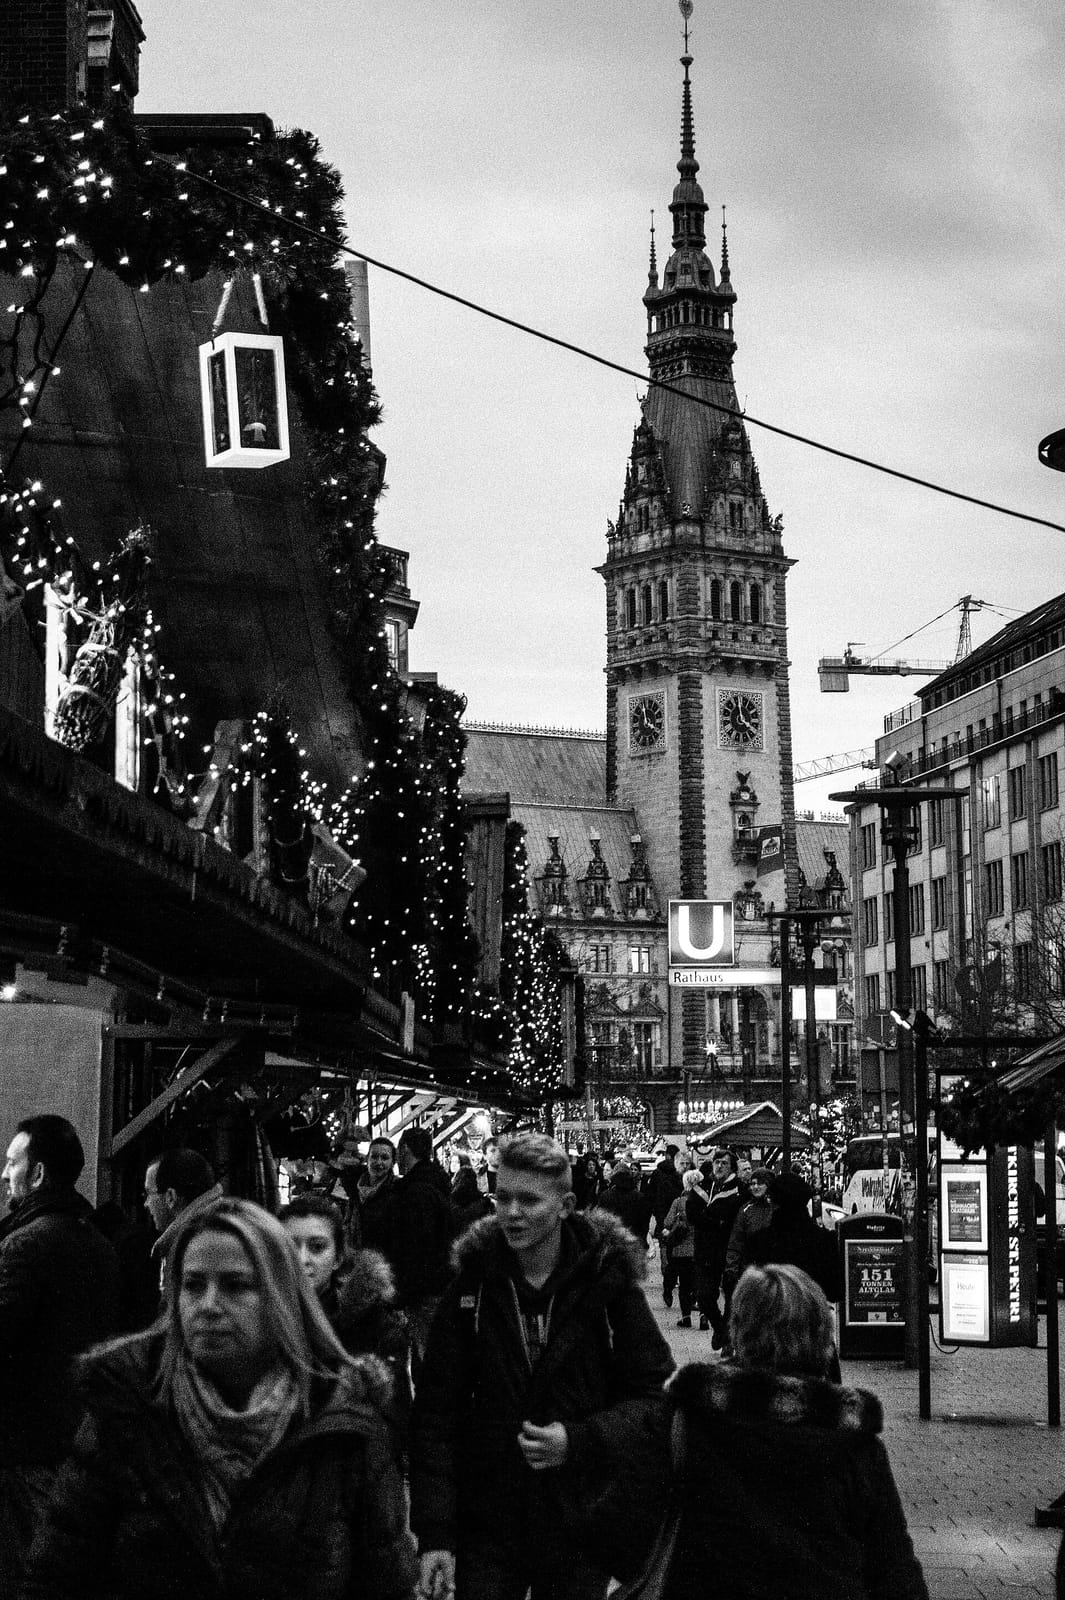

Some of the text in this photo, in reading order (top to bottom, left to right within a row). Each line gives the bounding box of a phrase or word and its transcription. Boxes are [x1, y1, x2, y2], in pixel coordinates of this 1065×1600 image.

[678, 905, 724, 960] U
[673, 971, 724, 983] Rathaus
[861, 1268, 893, 1281] 151
